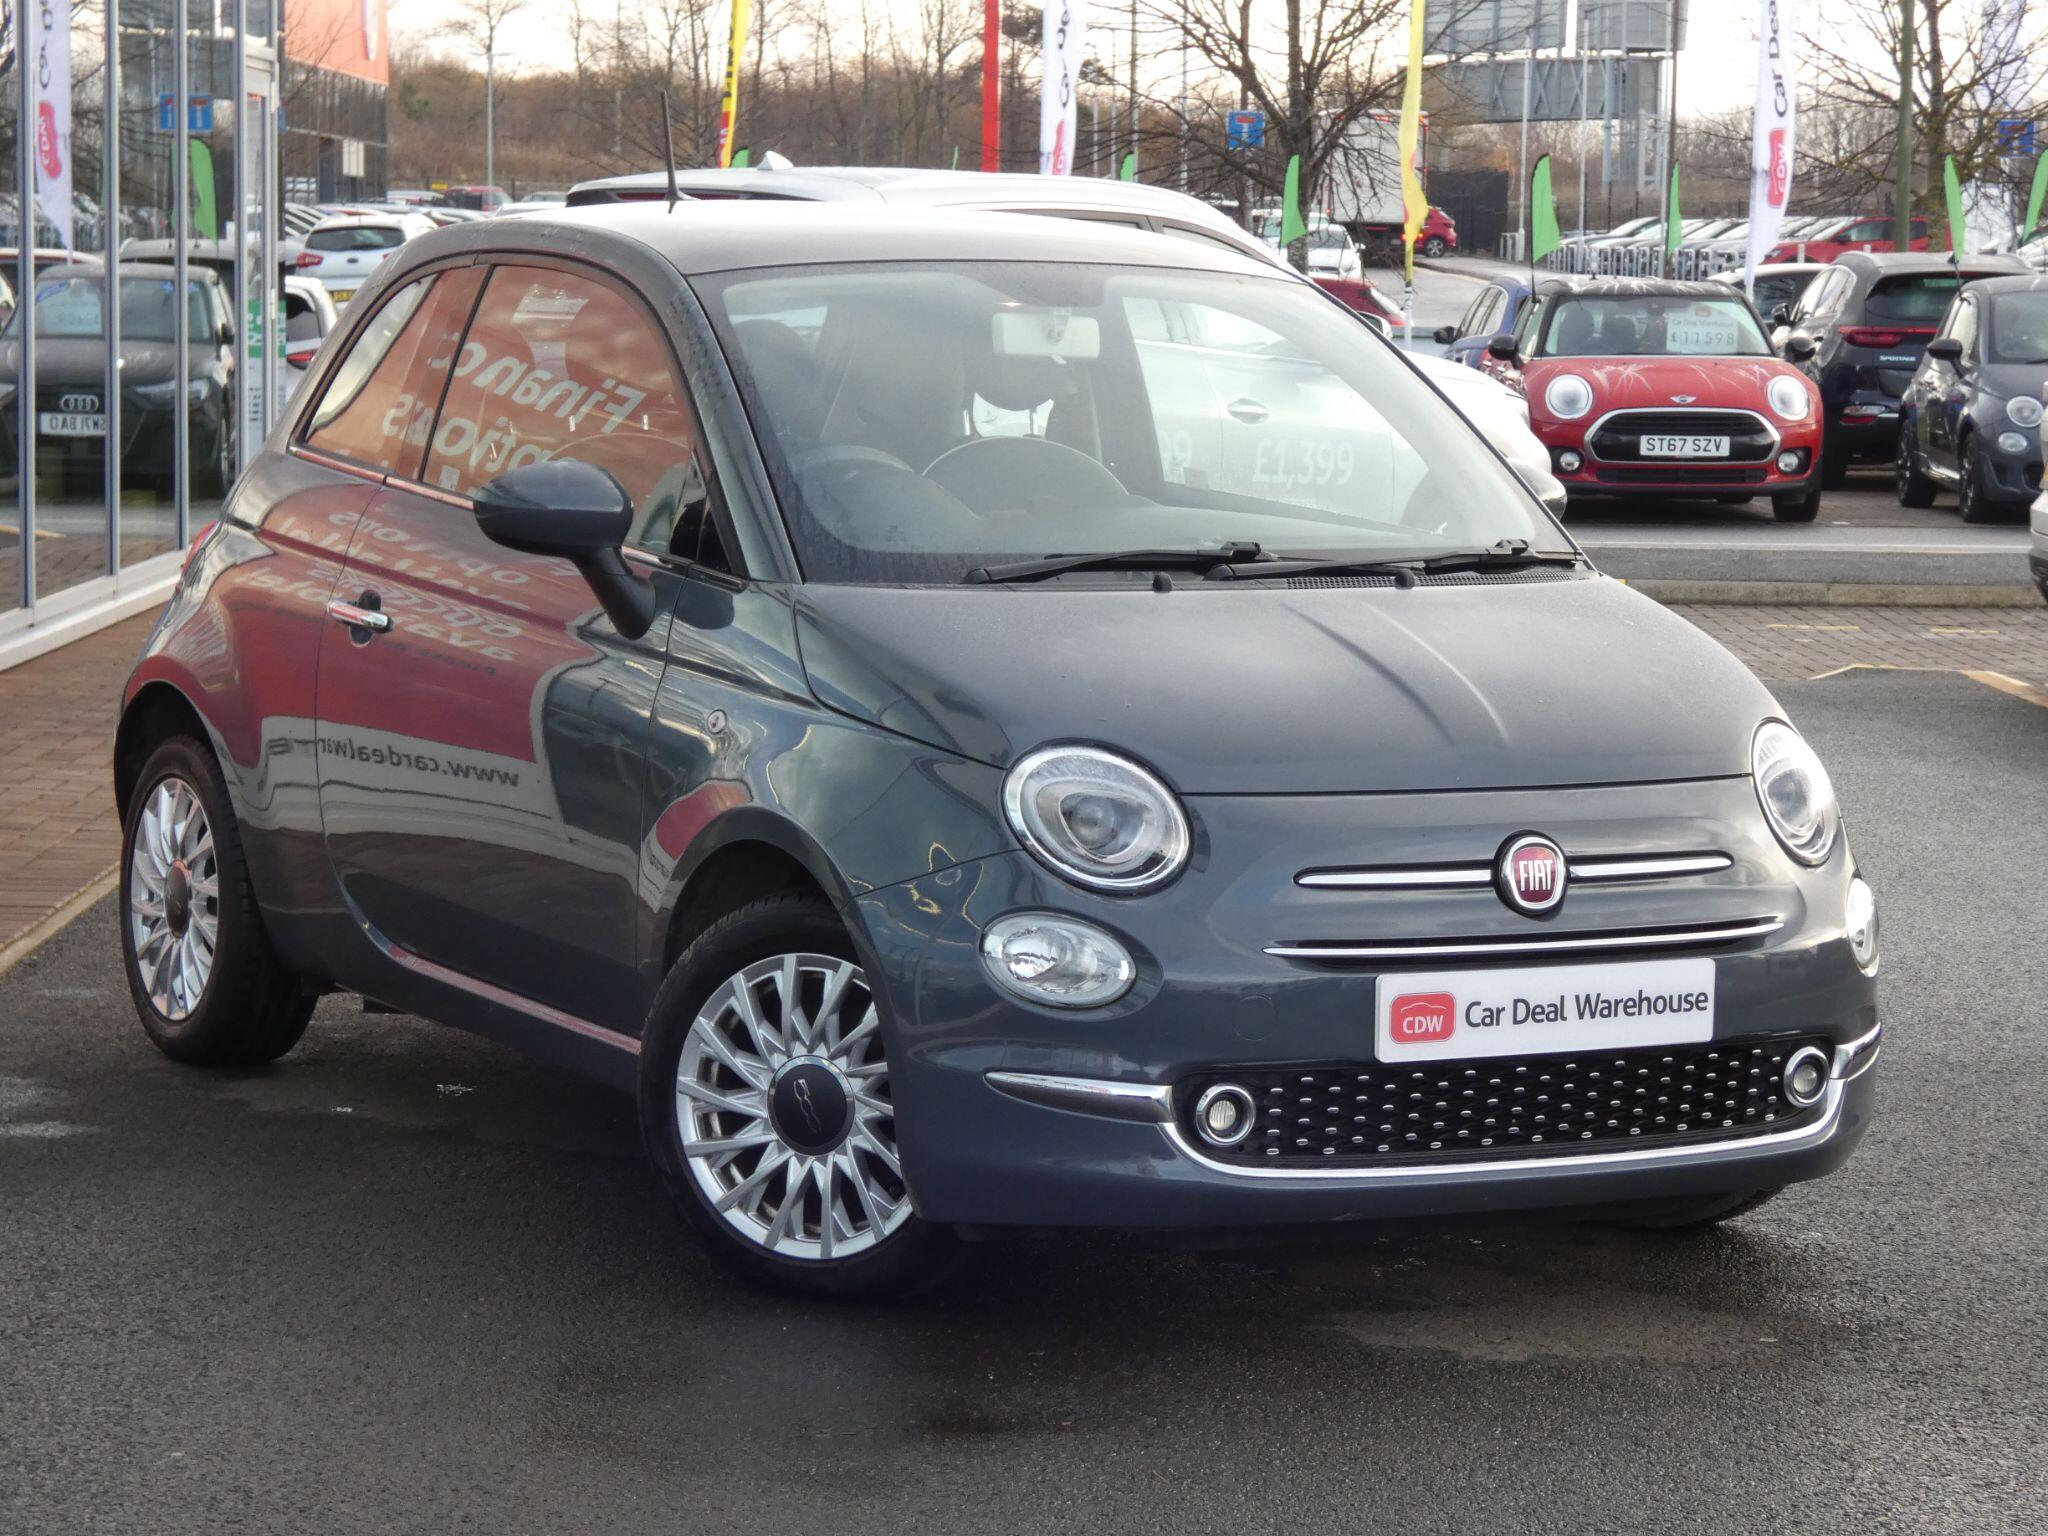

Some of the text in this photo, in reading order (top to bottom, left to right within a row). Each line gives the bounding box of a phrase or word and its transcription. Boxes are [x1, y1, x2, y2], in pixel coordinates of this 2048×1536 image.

[1773, 68, 1788, 119] Car
[1253, 438, 1354, 488] £1,399
[1646, 437, 1722, 453] ST67 SZV
[1518, 859, 1554, 892] FIAT
[1402, 988, 1709, 1034] CDW Car Deal Warehouse
